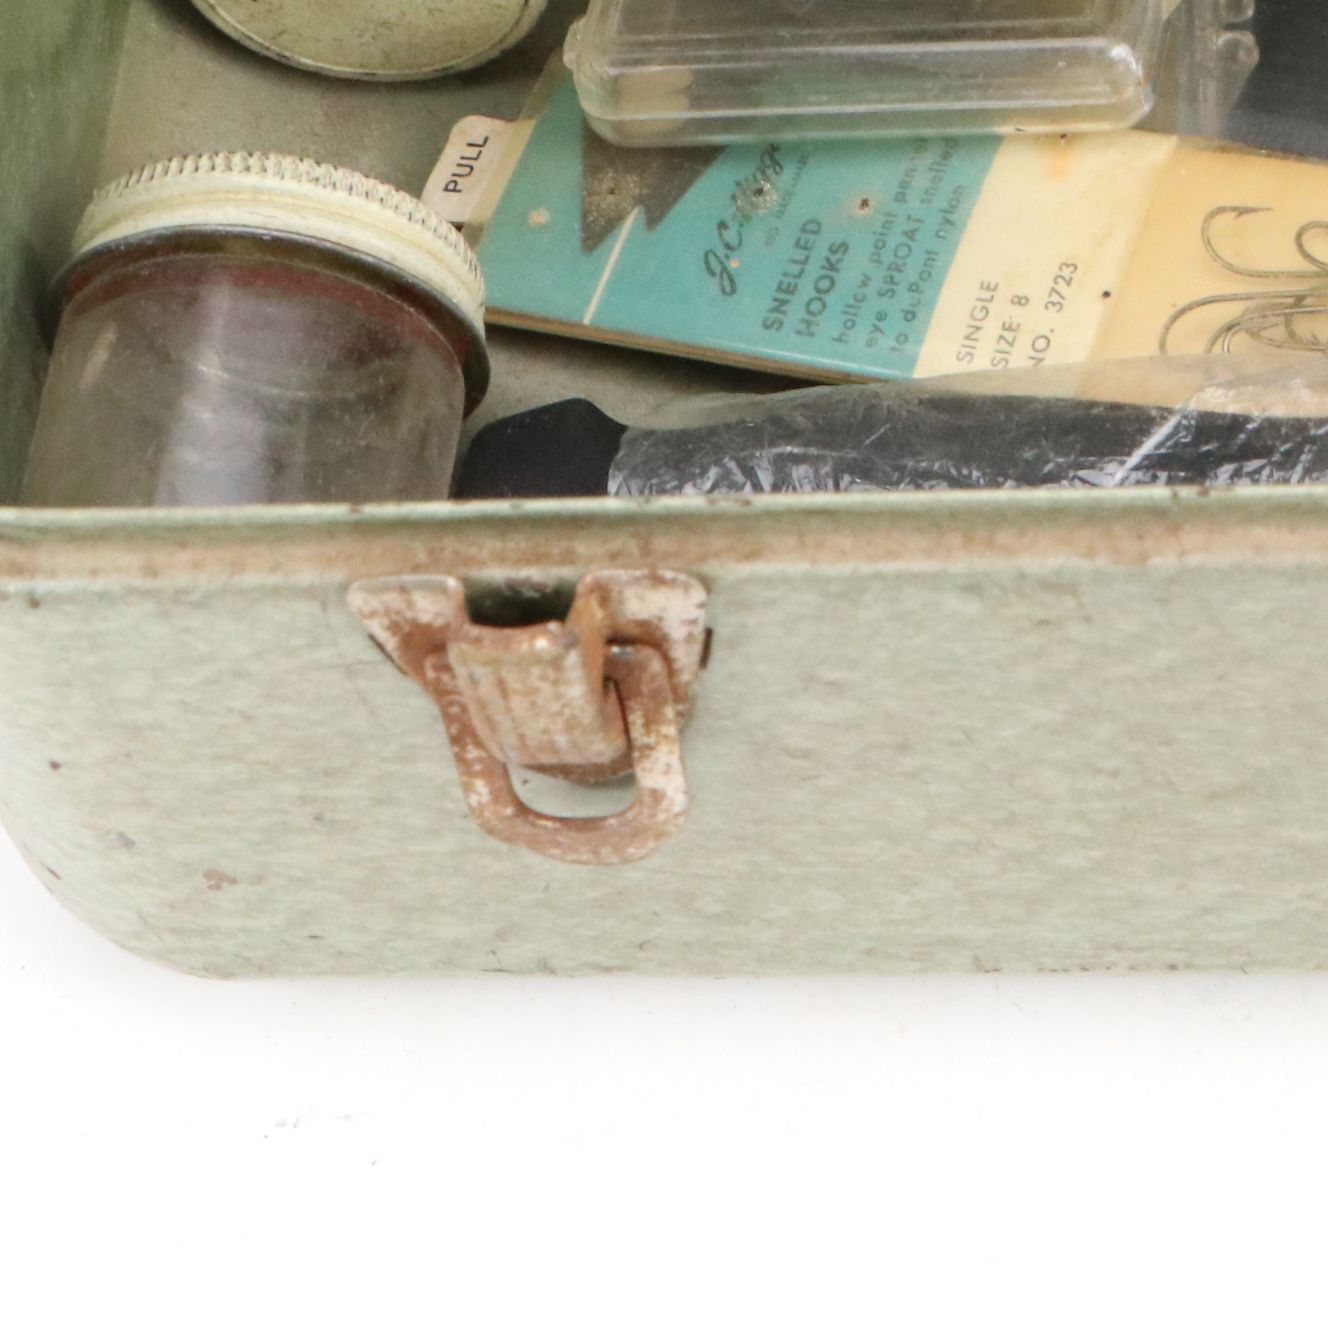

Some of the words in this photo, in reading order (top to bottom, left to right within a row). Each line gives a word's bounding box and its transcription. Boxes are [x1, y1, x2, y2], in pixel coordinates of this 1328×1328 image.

[442, 134, 489, 194] PULL
[762, 218, 823, 332] SNELLED
[795, 240, 850, 338] HOOKS
[831, 273, 873, 344] hollow
[870, 211, 897, 265] point
[864, 309, 889, 349] eye
[877, 213, 925, 300] SPROAT
[889, 331, 909, 353] to
[934, 183, 967, 241] nylon
[1044, 261, 1078, 313] 3723
[956, 280, 999, 364] SINGLE
[990, 319, 1020, 369] SIZE
[1010, 294, 1030, 308] 8
